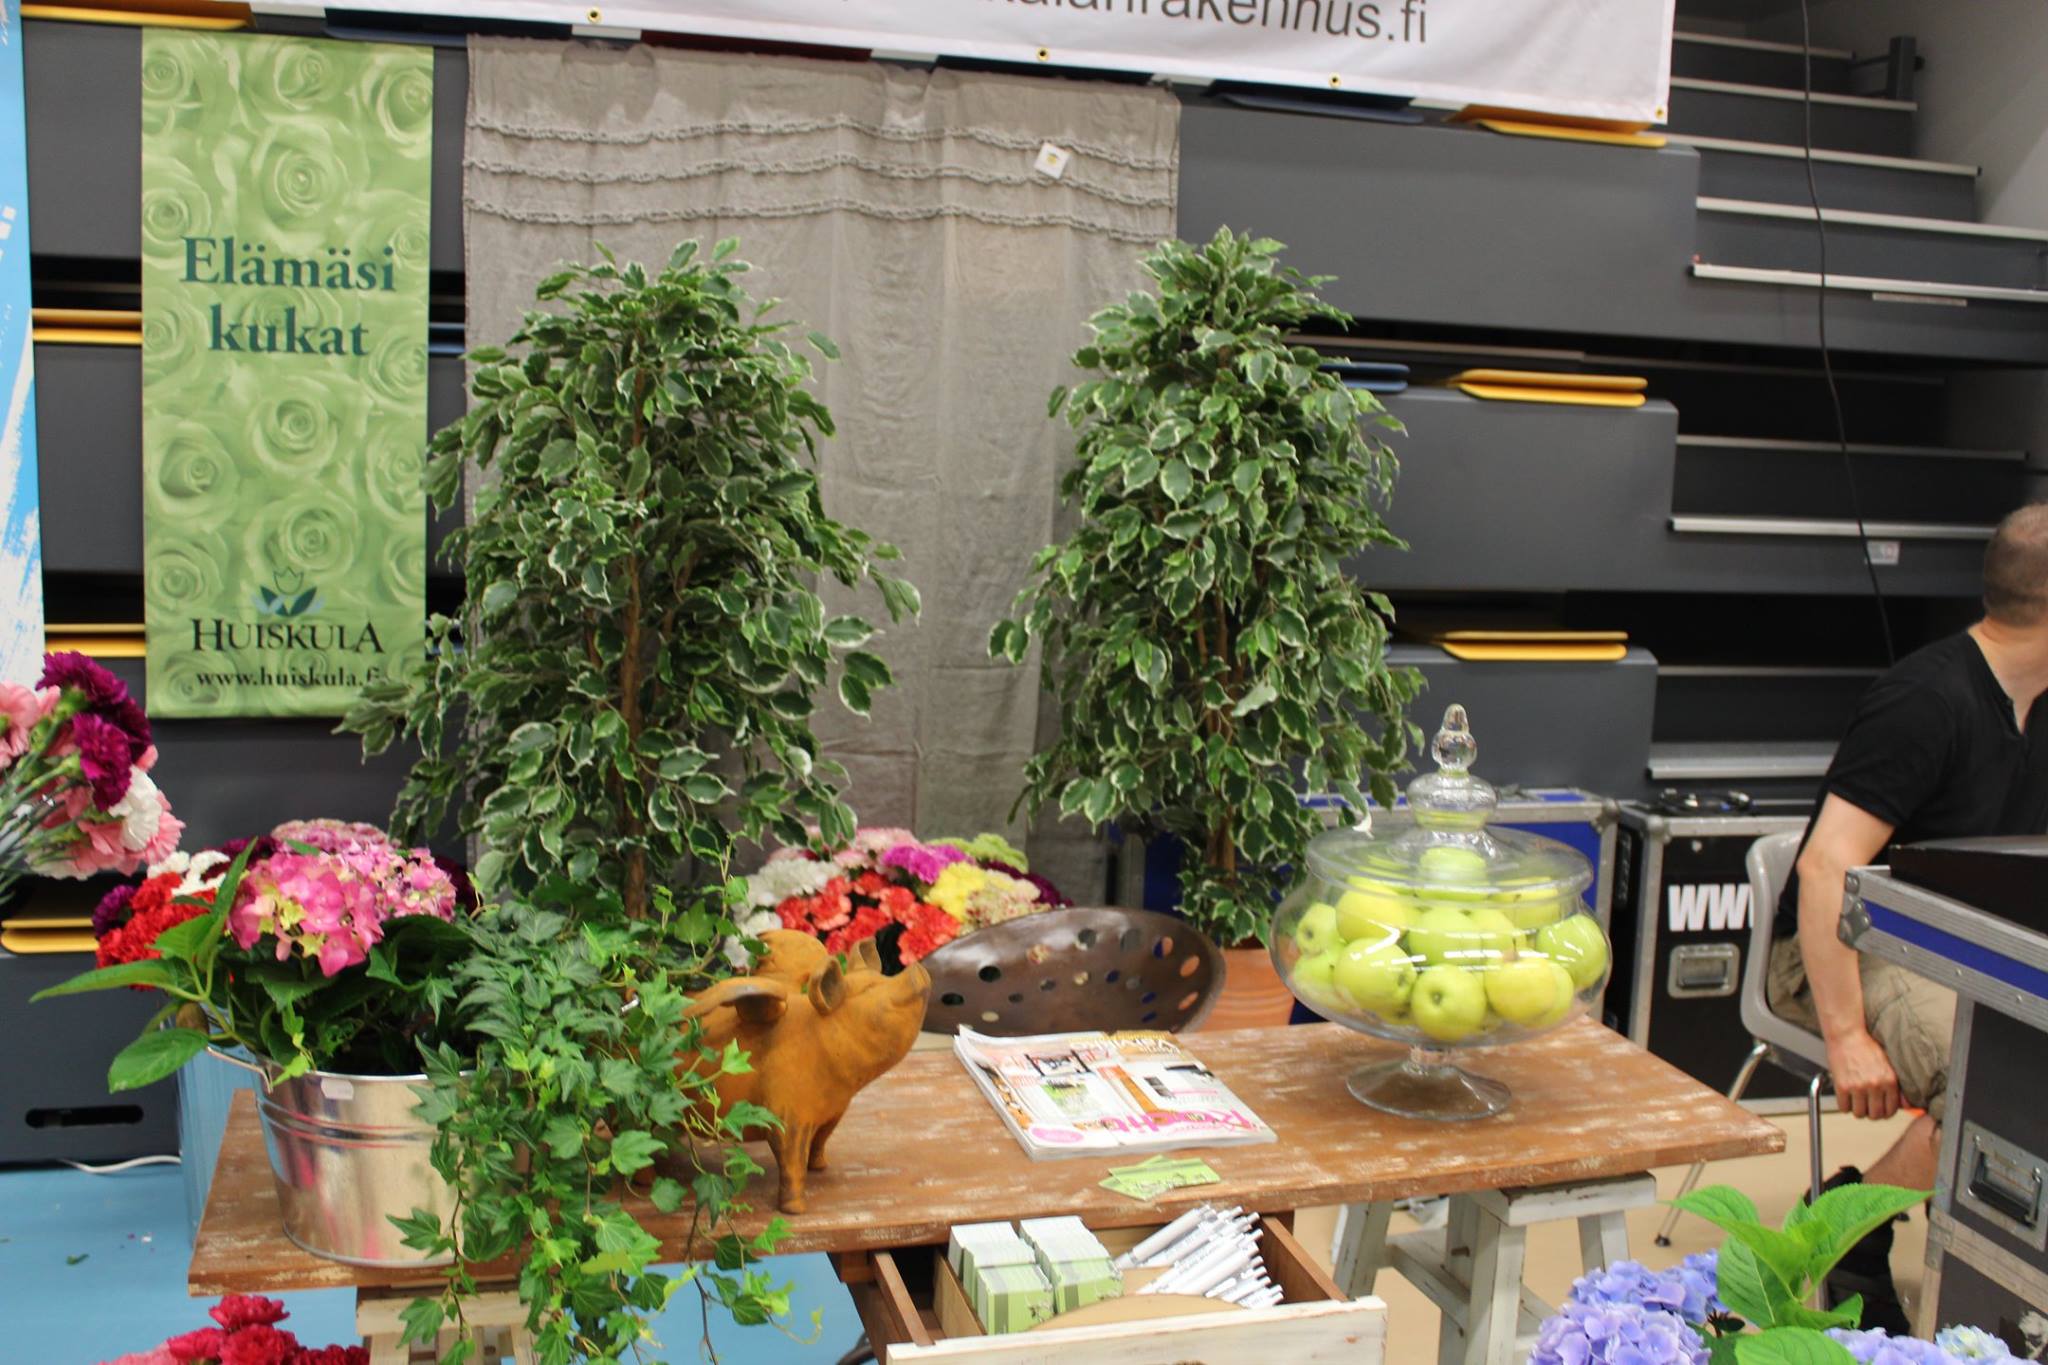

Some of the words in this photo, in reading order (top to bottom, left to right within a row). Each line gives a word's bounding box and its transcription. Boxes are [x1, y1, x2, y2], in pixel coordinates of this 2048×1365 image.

[180, 235, 396, 292] Elämäsi
[208, 303, 369, 356] kukat
[190, 617, 384, 654] HUISKULA
